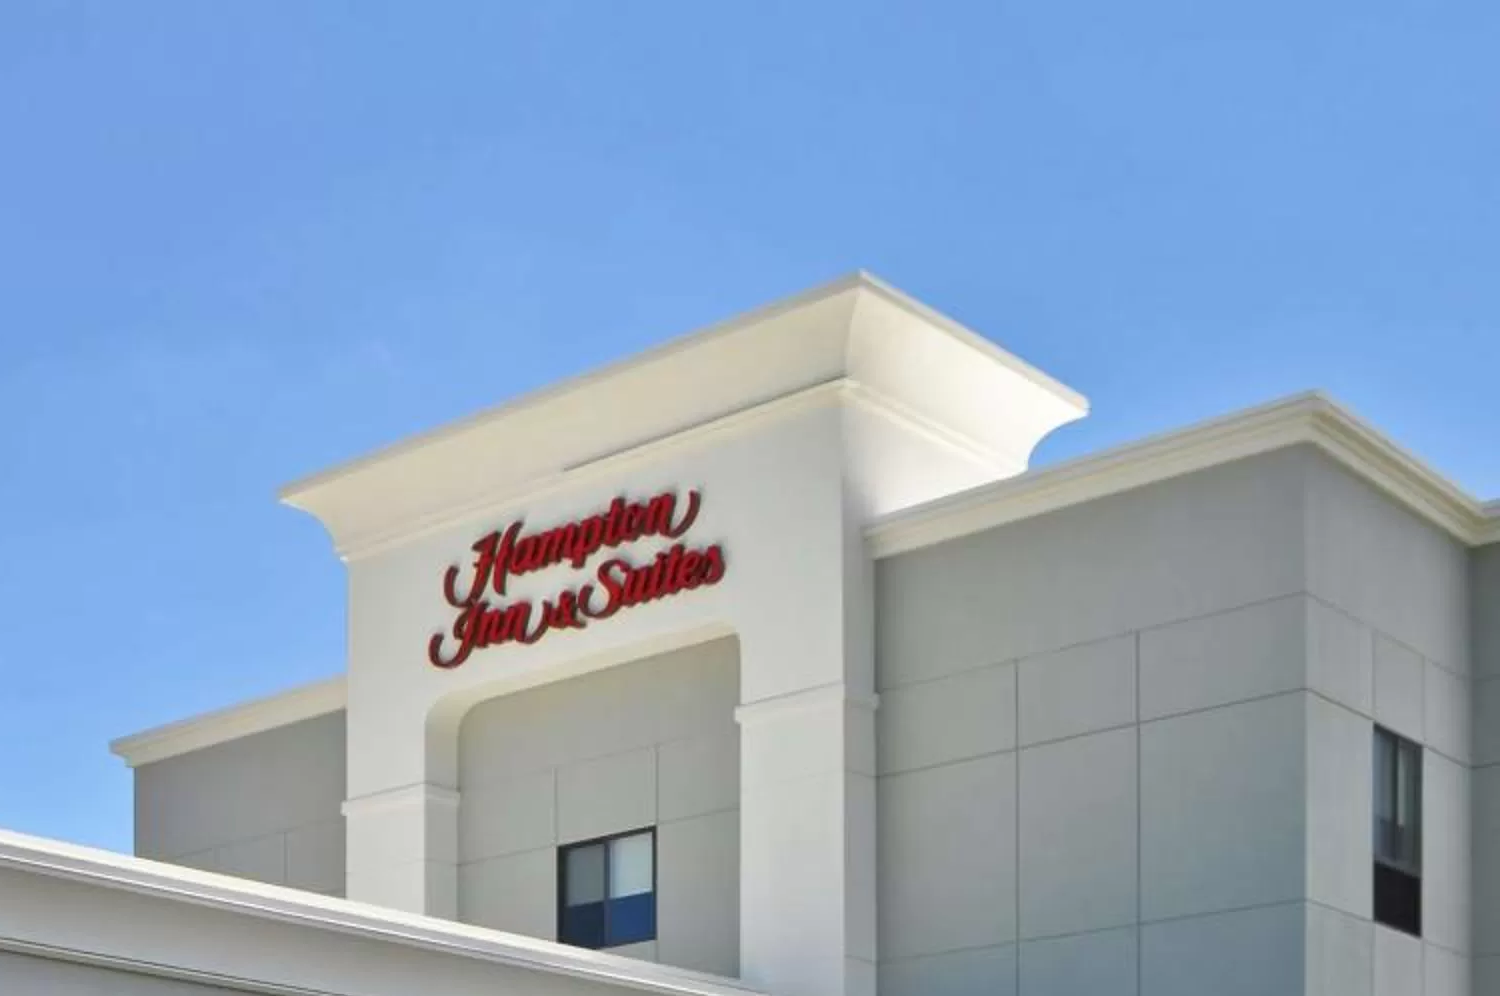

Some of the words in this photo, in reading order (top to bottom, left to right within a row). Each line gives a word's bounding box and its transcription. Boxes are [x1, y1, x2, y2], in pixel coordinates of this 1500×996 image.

[427, 598, 549, 669] Inn
[546, 590, 587, 630] &
[578, 543, 726, 620] Suites
[443, 489, 701, 608] Hampton
